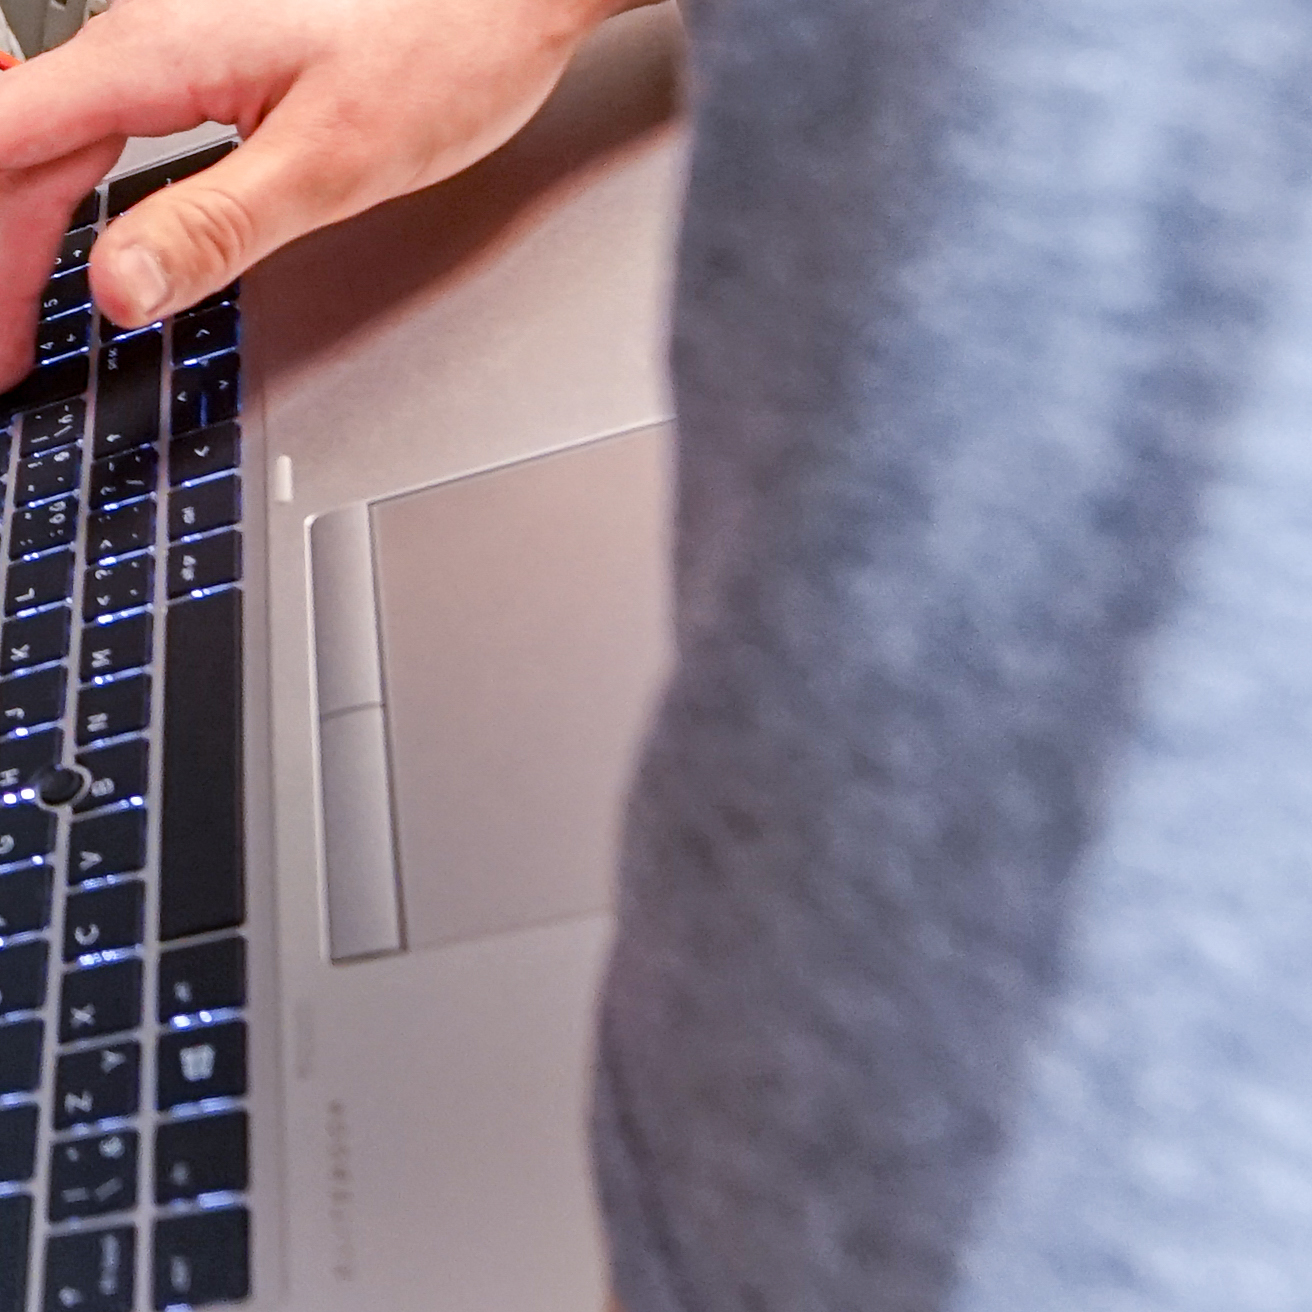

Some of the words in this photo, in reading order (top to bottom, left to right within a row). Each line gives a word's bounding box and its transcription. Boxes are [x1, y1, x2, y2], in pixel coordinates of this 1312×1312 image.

[44, 298, 58, 308] 5
[40, 340, 54, 350] 4
[14, 588, 35, 602] L
[10, 643, 30, 662] K
[92, 648, 112, 669] M
[5, 706, 25, 718] J
[87, 712, 108, 733] N
[91, 777, 115, 797] B
[79, 850, 103, 871] V
[74, 923, 100, 946] C
[70, 1004, 96, 1027] X
[100, 1049, 126, 1074] Y
[64, 1090, 94, 1114] Z
